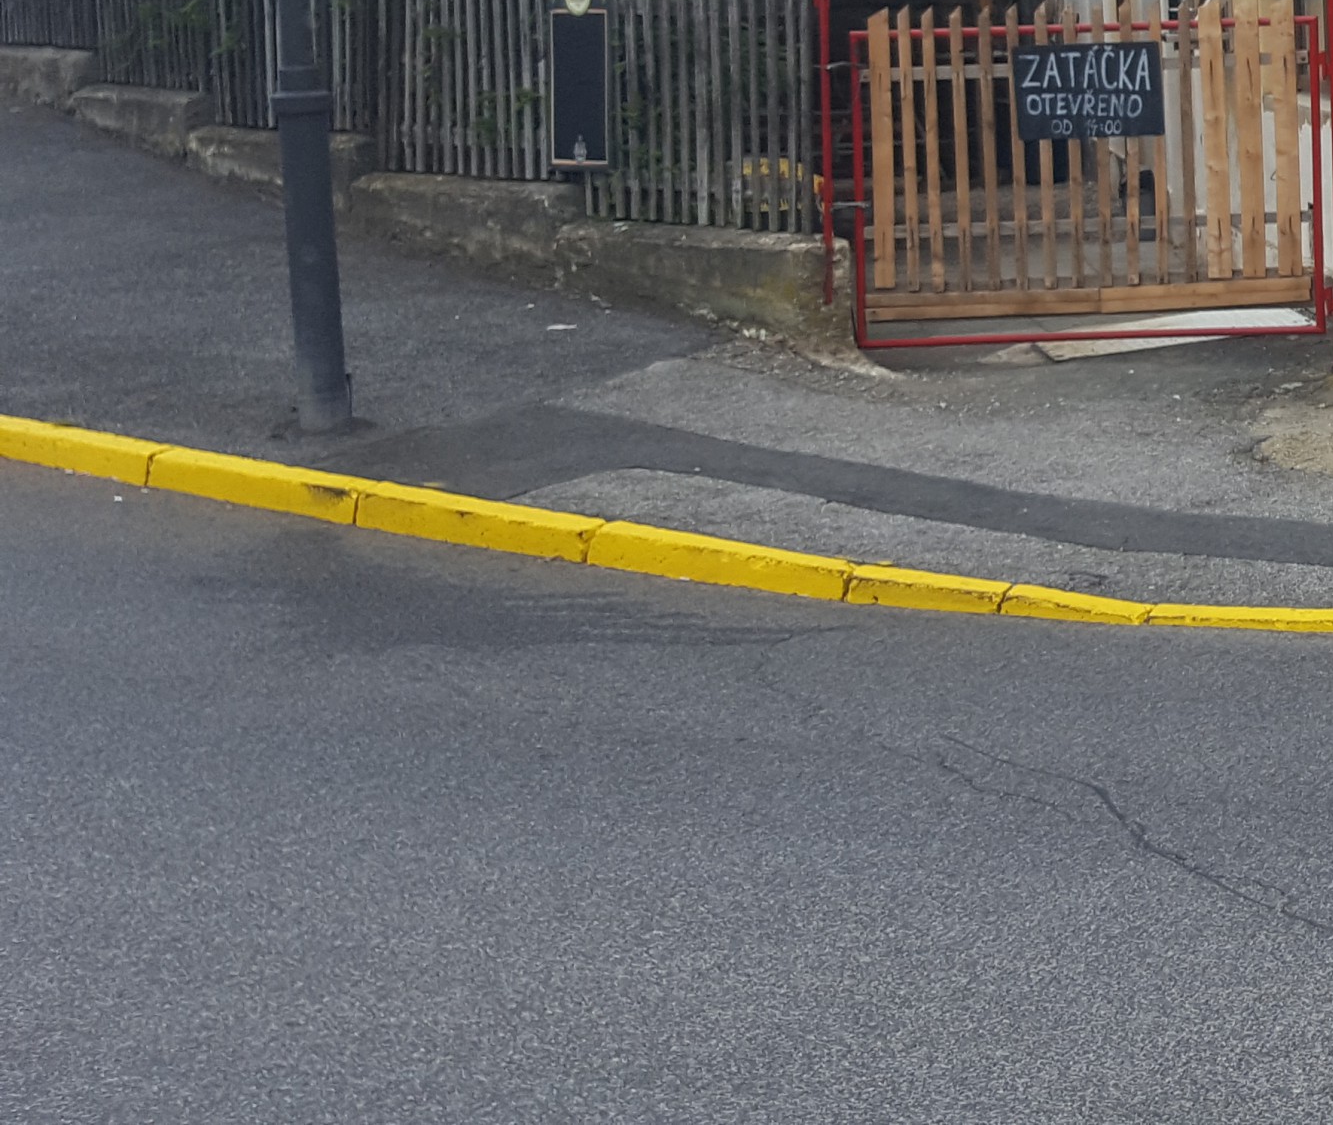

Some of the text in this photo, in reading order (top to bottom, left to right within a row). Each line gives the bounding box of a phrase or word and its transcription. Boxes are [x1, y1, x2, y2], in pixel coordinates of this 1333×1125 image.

[1018, 45, 1151, 91] ZATÁČKA
[1026, 89, 1143, 118] OTEVŘENO
[1051, 119, 1073, 135] OD
